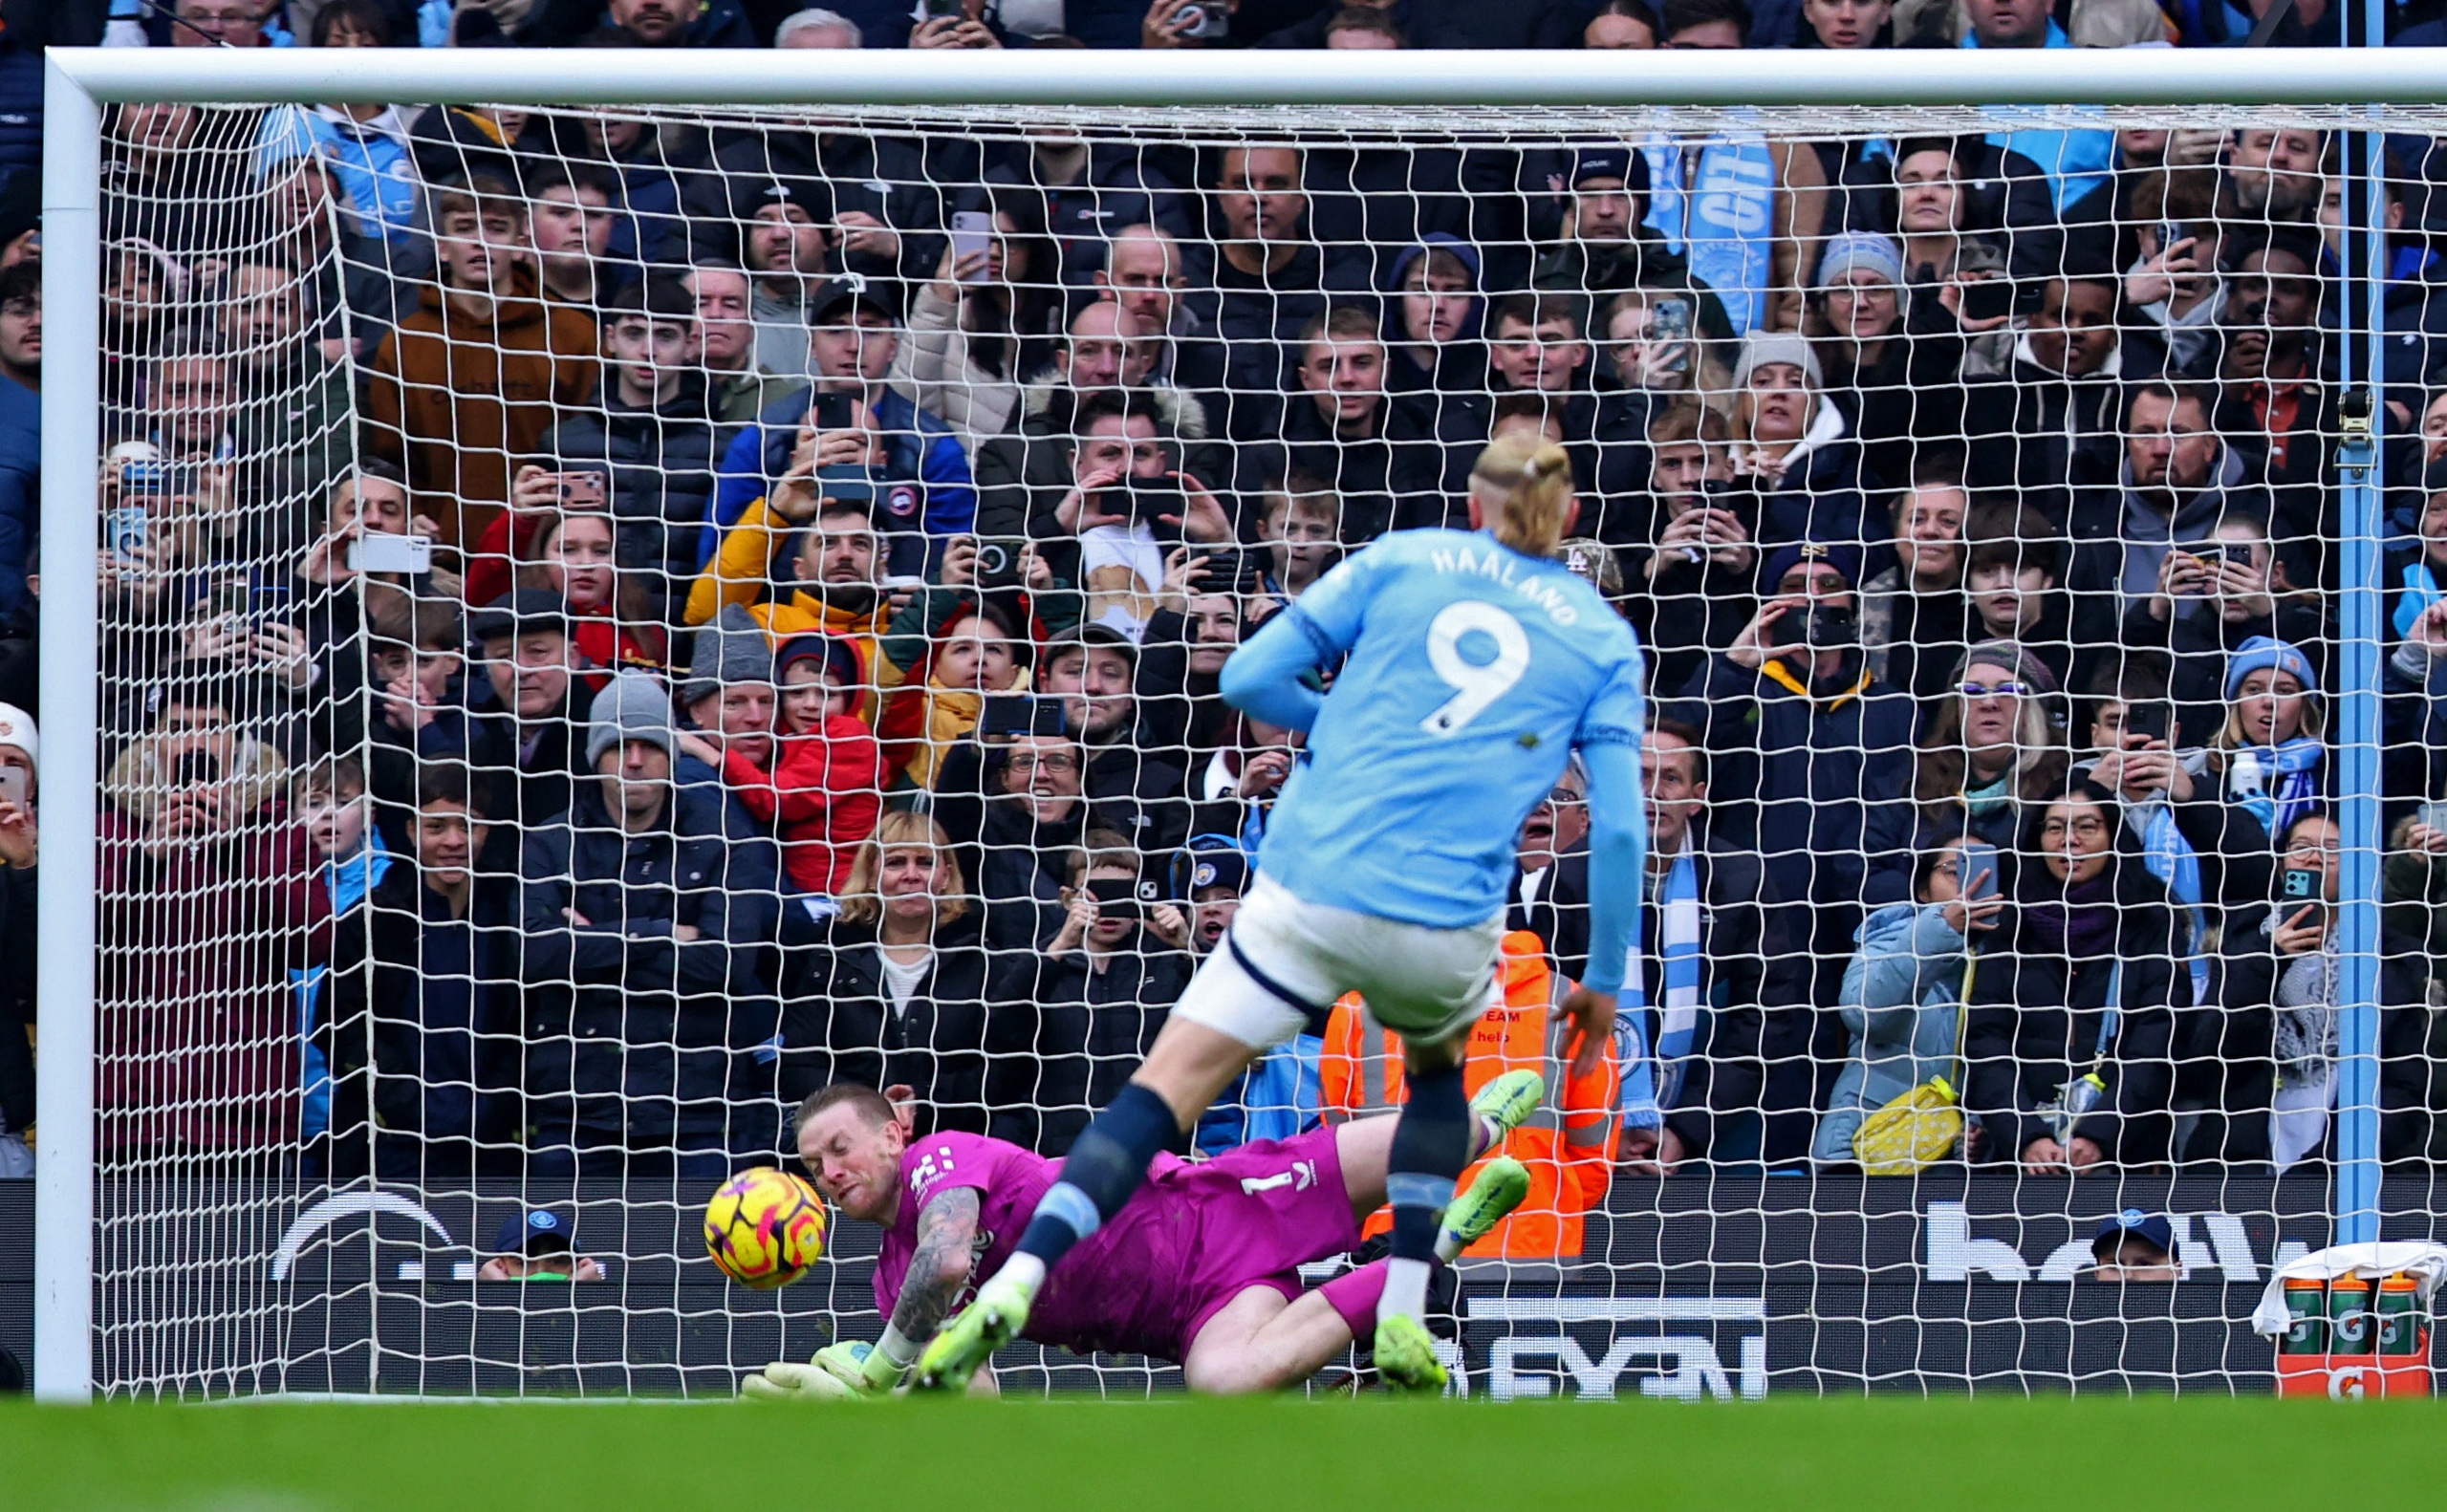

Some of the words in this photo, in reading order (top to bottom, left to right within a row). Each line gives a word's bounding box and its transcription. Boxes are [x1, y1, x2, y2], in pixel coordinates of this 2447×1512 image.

[1565, 548, 1587, 571] LA
[1430, 546, 1578, 627] HAALAND
[1418, 599, 1530, 739] 9
[1484, 1011, 1520, 1022] EAM
[1241, 1171, 1293, 1196] 1
[2337, 1308, 2365, 1342] G
[2328, 1366, 2365, 1403] G
